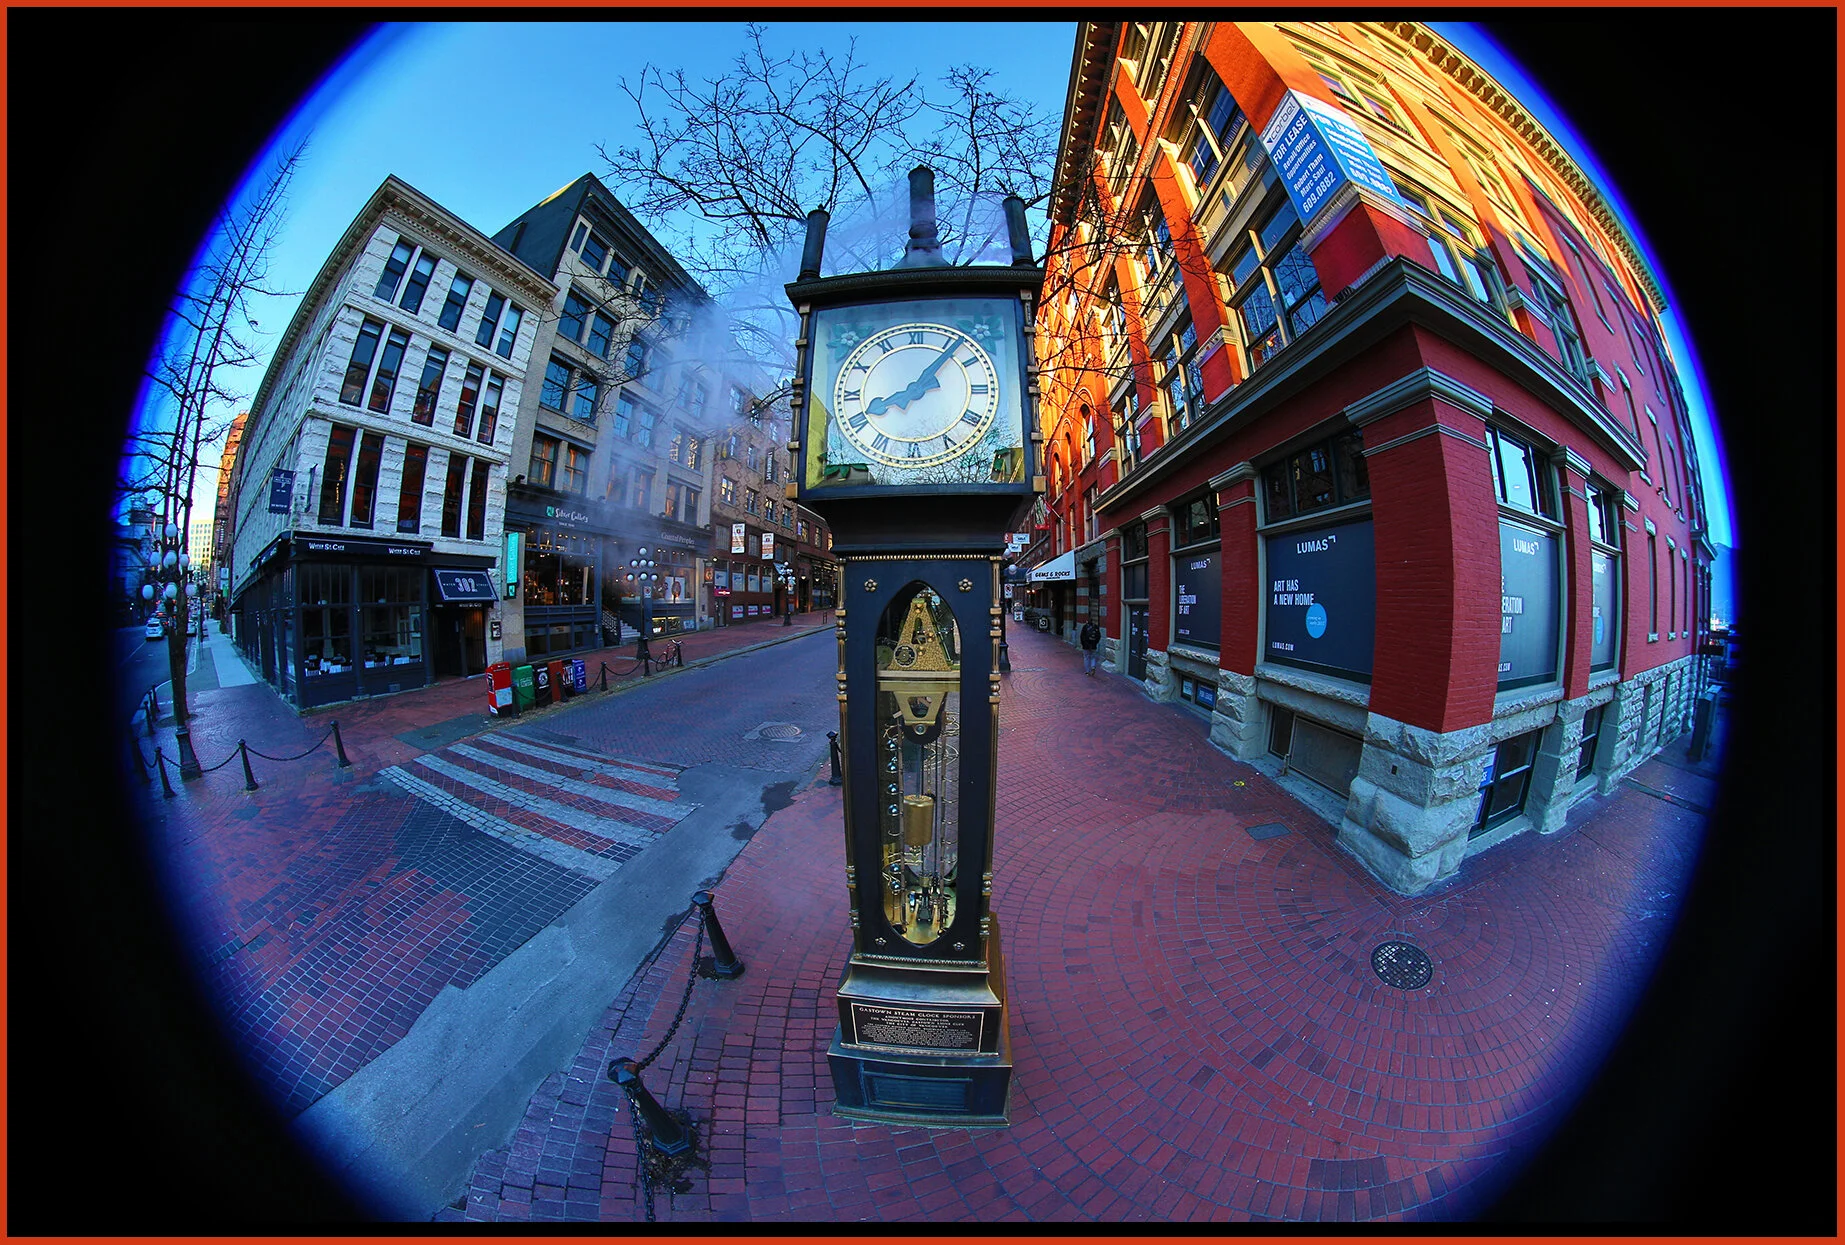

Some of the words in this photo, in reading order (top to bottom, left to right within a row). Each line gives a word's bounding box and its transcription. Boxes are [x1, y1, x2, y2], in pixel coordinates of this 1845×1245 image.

[1270, 101, 1296, 141] corbel
[1273, 143, 1287, 164] FOR
[1284, 114, 1308, 146] LEASE
[1286, 140, 1317, 180] Opportunities
[1294, 170, 1310, 192] Robert
[1308, 154, 1324, 173] Tham
[1300, 180, 1314, 198] Marc
[1312, 164, 1326, 182] Saul
[1302, 171, 1336, 213] 609.0882
[909, 332, 923, 344] XII
[1297, 538, 1328, 554] LUMAS
[1514, 538, 1535, 555] LUMAS
[1191, 560, 1207, 570] LUMAS
[455, 578, 478, 592] 302
[1274, 580, 1285, 592] ART
[1286, 579, 1299, 591] HAS
[1274, 594, 1278, 605] A
[1279, 594, 1293, 605] NEW
[1295, 593, 1314, 606] HOME
[1502, 596, 1522, 614] ERATION
